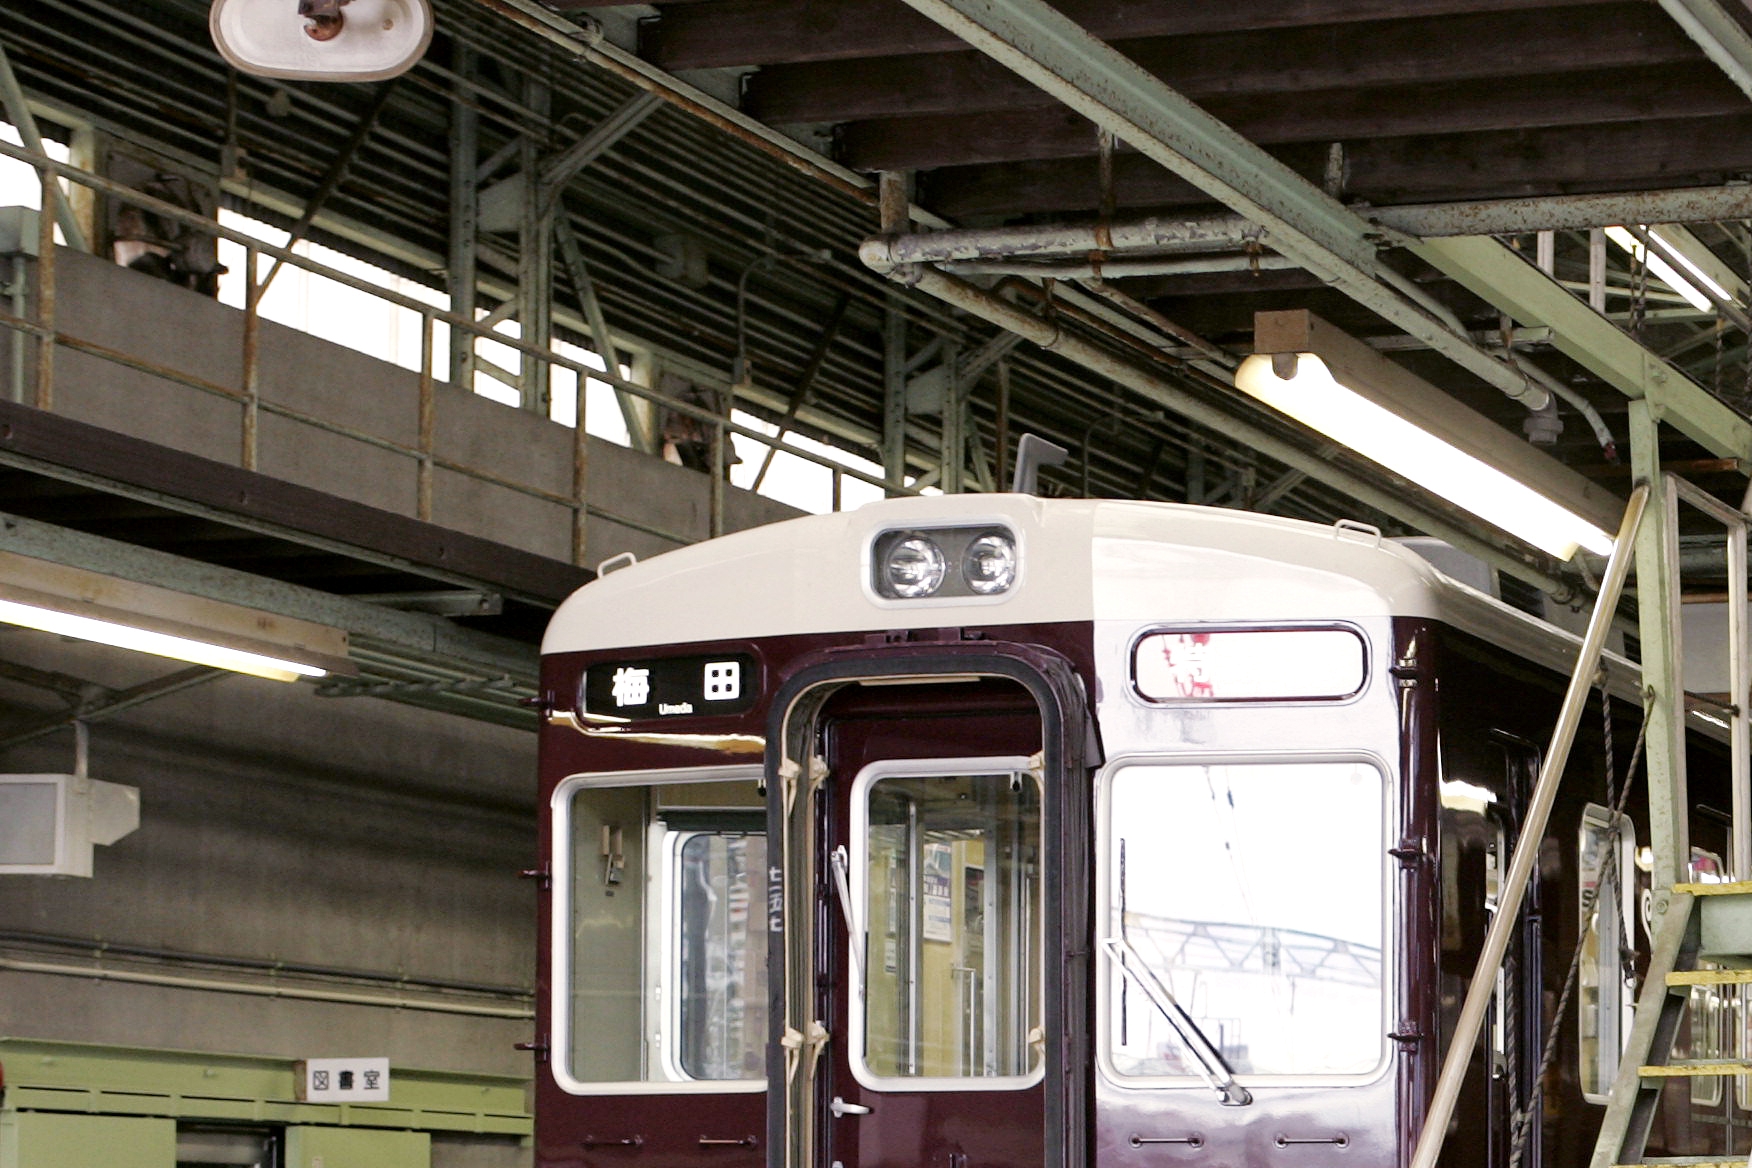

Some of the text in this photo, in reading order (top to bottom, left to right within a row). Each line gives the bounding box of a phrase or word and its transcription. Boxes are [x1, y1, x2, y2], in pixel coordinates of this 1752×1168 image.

[612, 661, 740, 707] 梅田
[313, 1068, 380, 1091] 図書室
